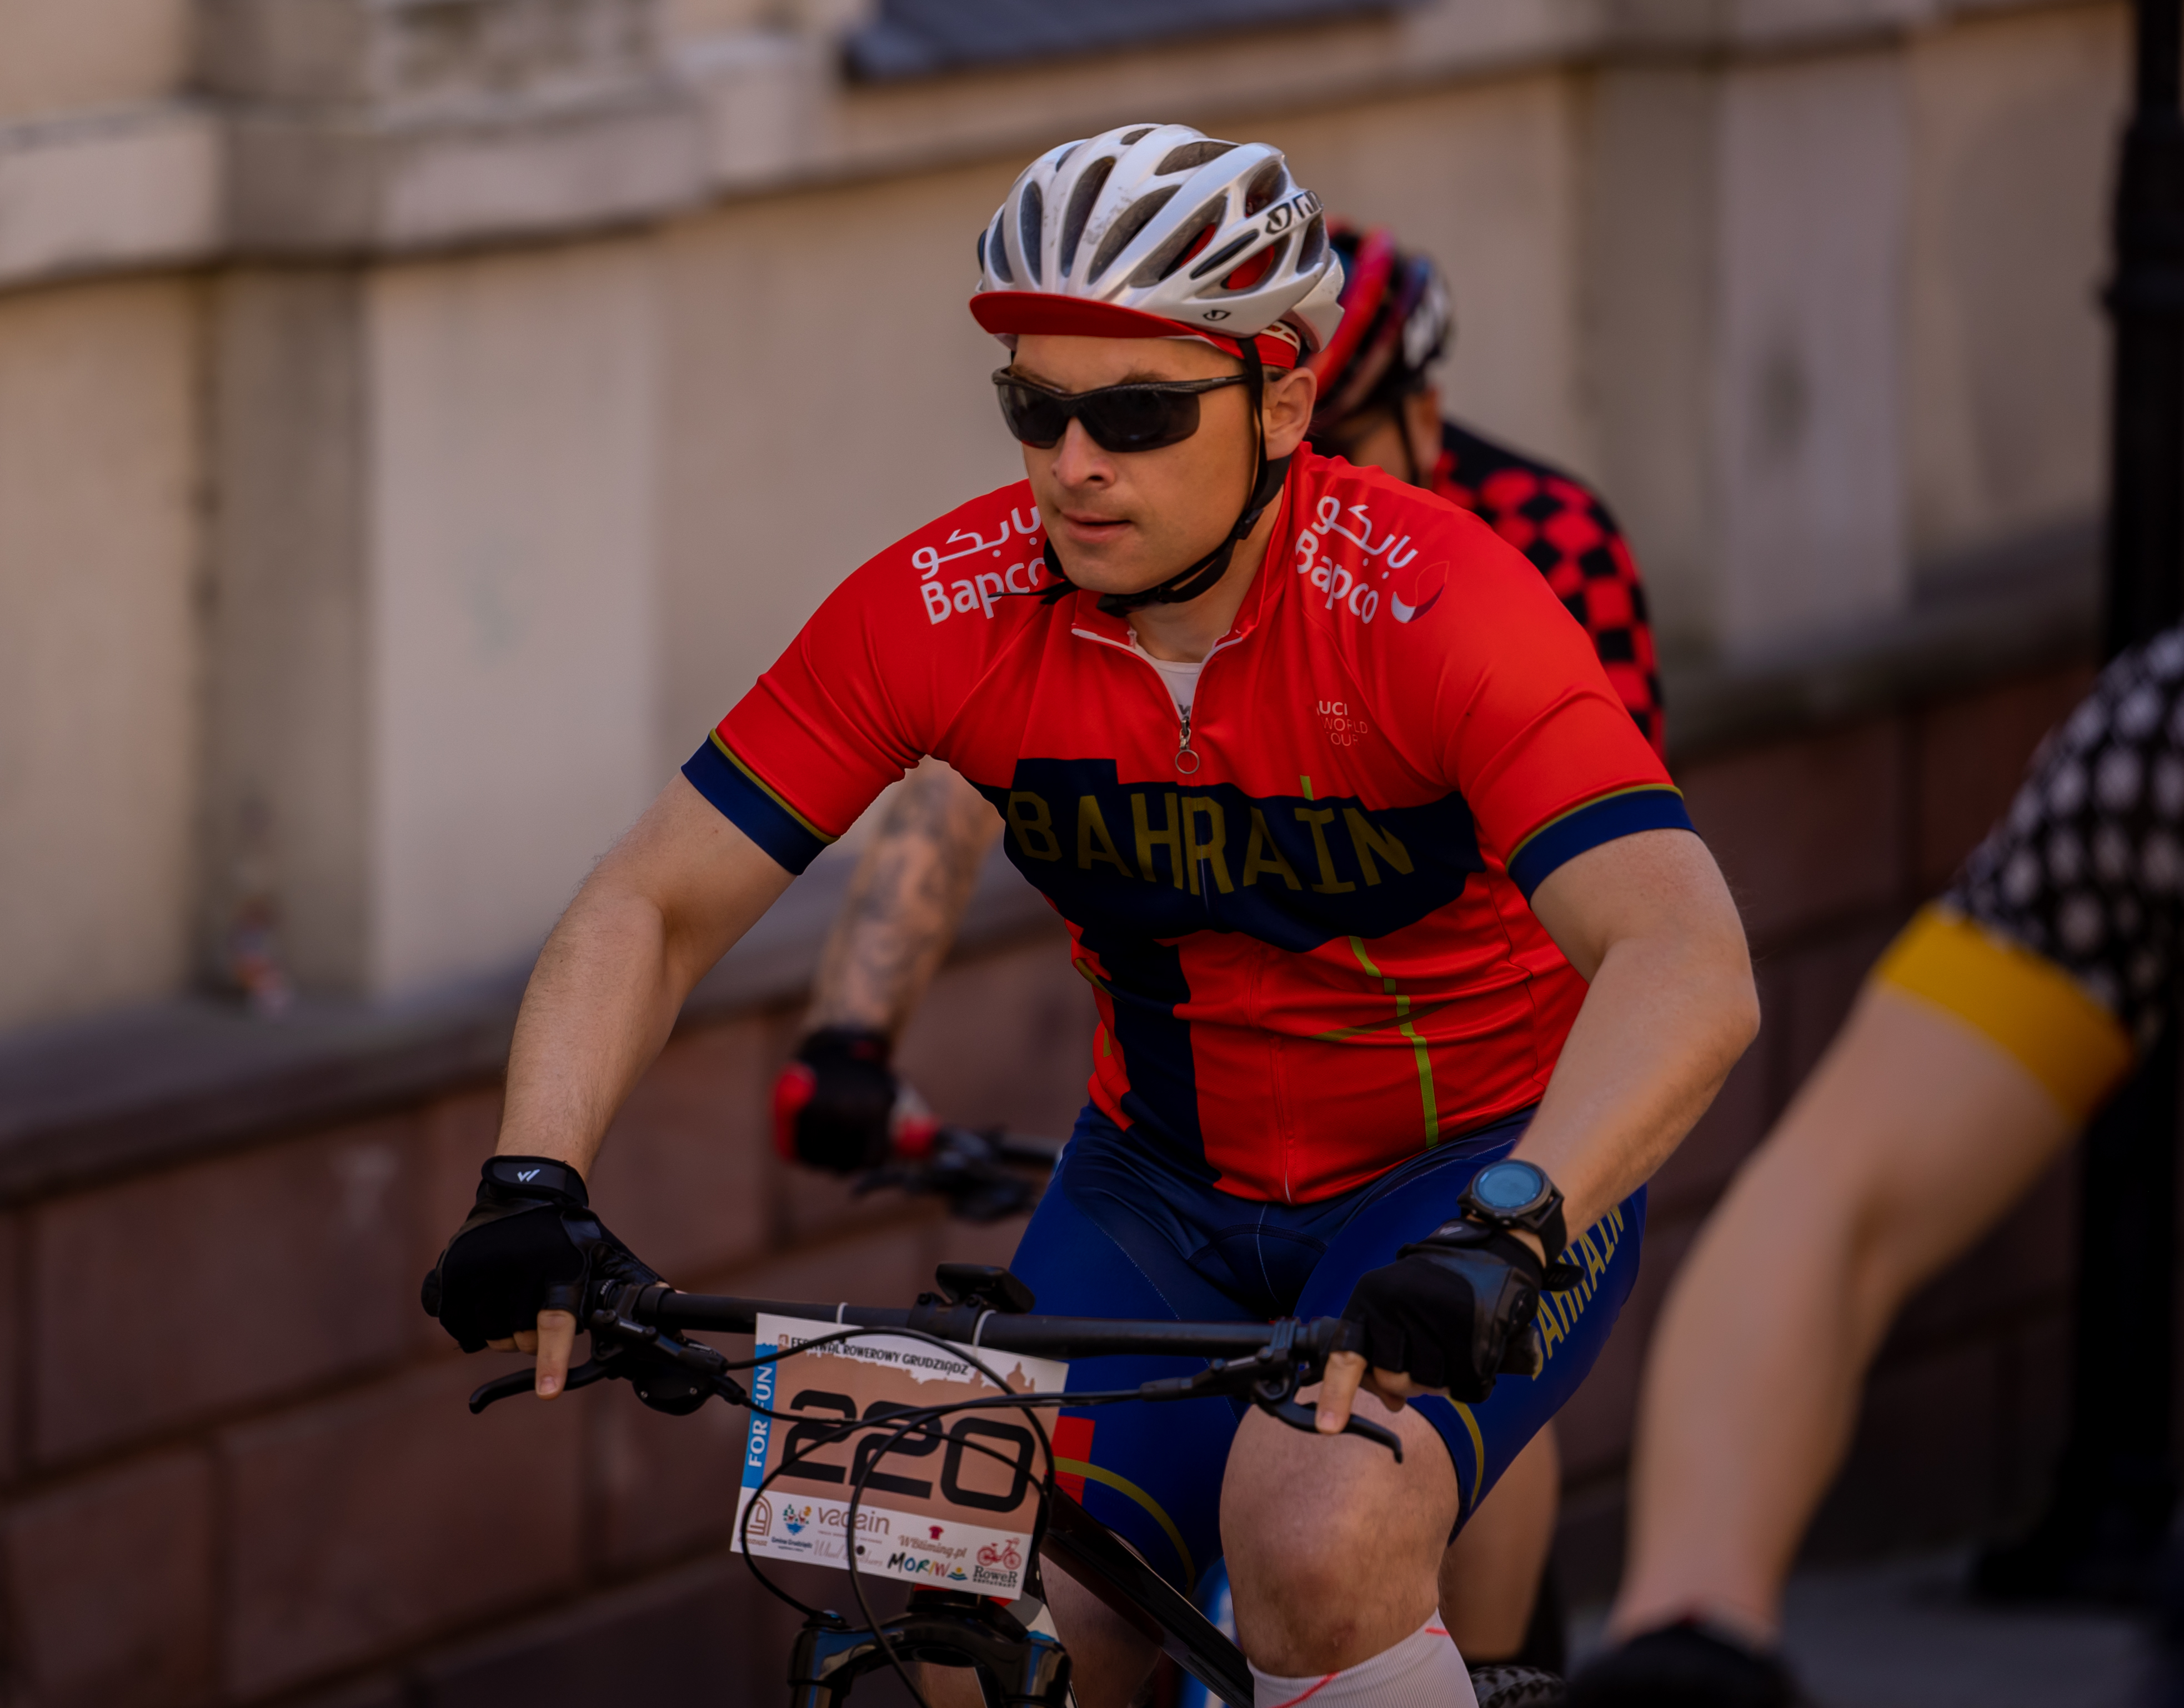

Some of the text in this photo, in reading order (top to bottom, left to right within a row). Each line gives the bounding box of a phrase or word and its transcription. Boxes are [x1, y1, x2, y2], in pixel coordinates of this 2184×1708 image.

[1295, 529, 1379, 624] Bapco
[1316, 700, 1348, 716] UCI
[1007, 790, 1415, 896] BAHRAIN
[843, 1344, 901, 1363] ROWEROWY
[902, 1353, 969, 1375] GRUDZIĄDZ
[748, 1420, 768, 1467] FOR
[782, 1389, 1035, 1513] 220
